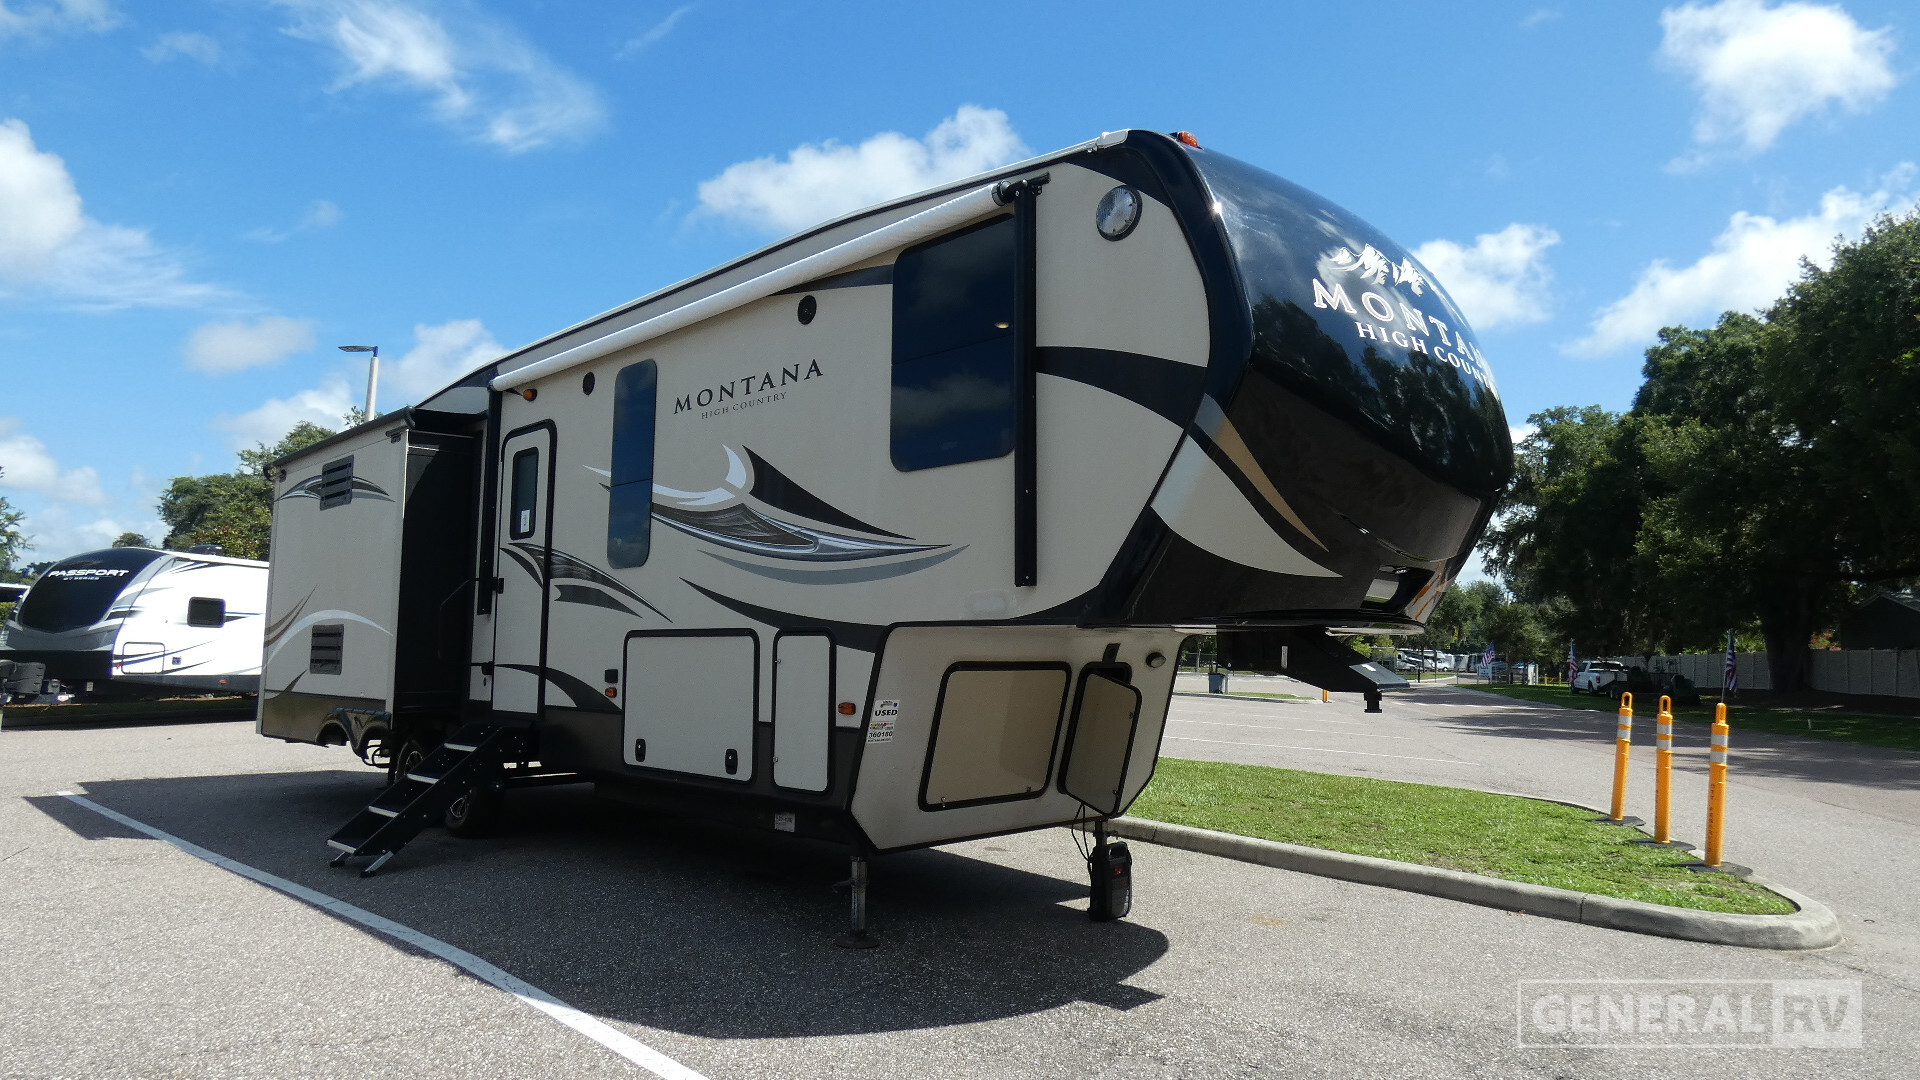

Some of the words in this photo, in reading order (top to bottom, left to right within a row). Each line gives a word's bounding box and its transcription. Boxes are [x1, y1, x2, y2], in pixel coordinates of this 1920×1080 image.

[1312, 278, 1487, 371] MONTAN
[1354, 321, 1429, 355] HIGH
[1433, 345, 1500, 401] COUNT
[673, 358, 824, 415] MONTANA
[701, 406, 730, 420] HIGH
[732, 391, 788, 412] COUNTRY
[48, 569, 130, 577] PASSPORT
[874, 709, 898, 717] USED
